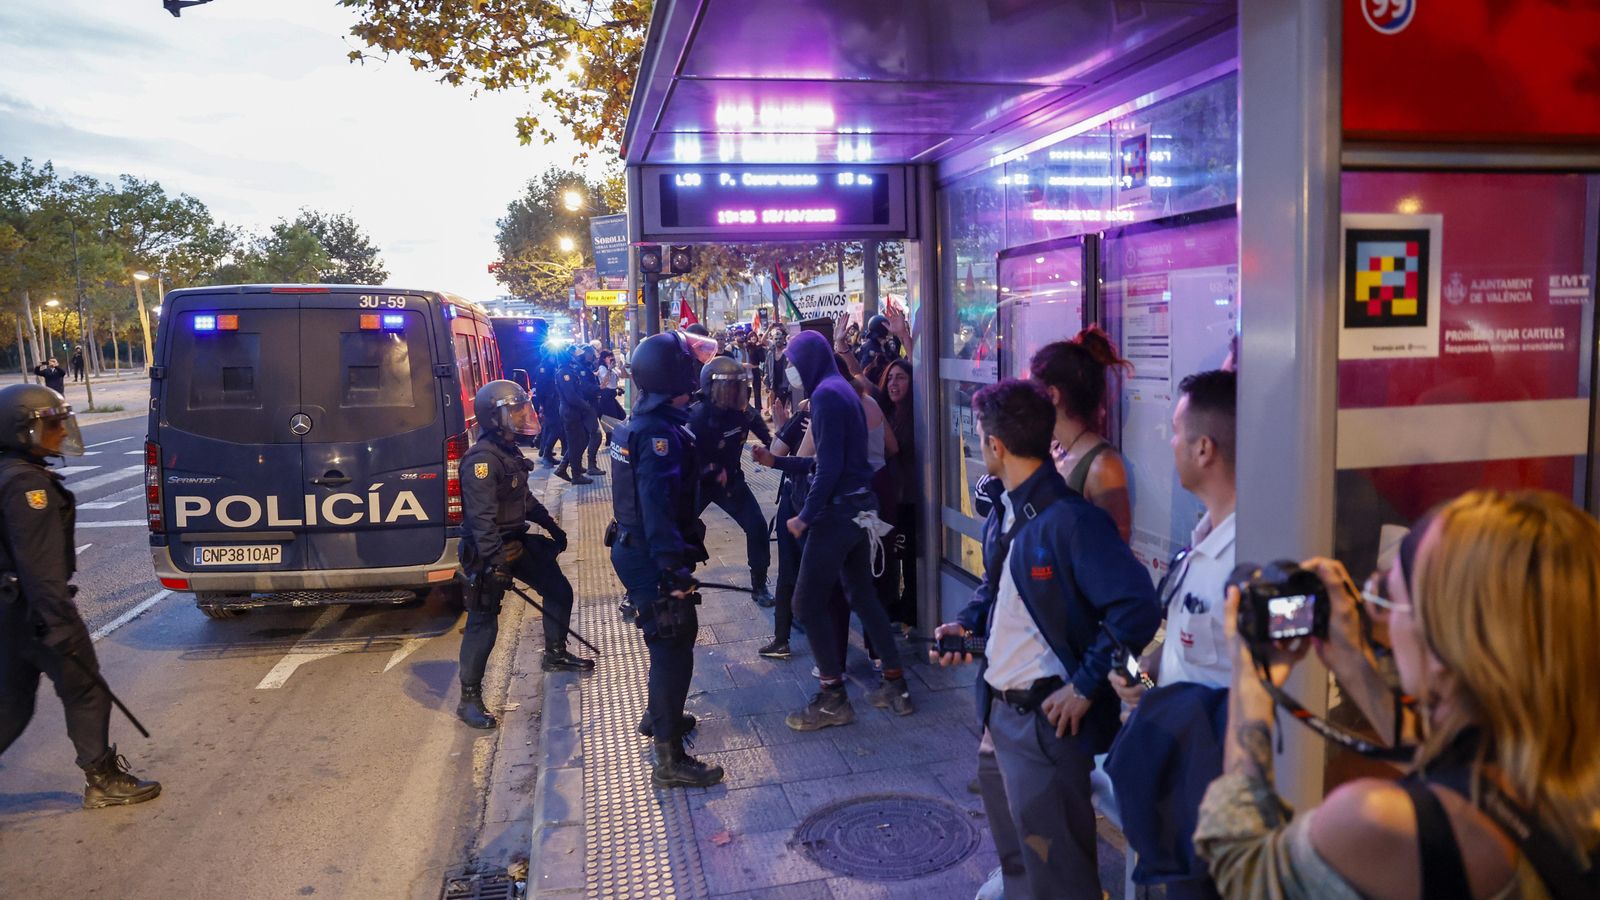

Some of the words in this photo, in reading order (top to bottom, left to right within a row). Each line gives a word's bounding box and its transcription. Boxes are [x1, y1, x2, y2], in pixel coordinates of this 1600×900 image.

[1471, 278, 1533, 290] AJUNTAMENT
[1549, 275, 1591, 287] EMT
[359, 295, 406, 309] 3U-59
[817, 293, 846, 307] NIÑOS
[1470, 293, 1482, 303] DE
[1521, 328, 1565, 339] CARTELES
[168, 476, 217, 484] SPRINTER
[175, 483, 430, 528] POLICÍA
[202, 547, 279, 562] CNP3810AP
